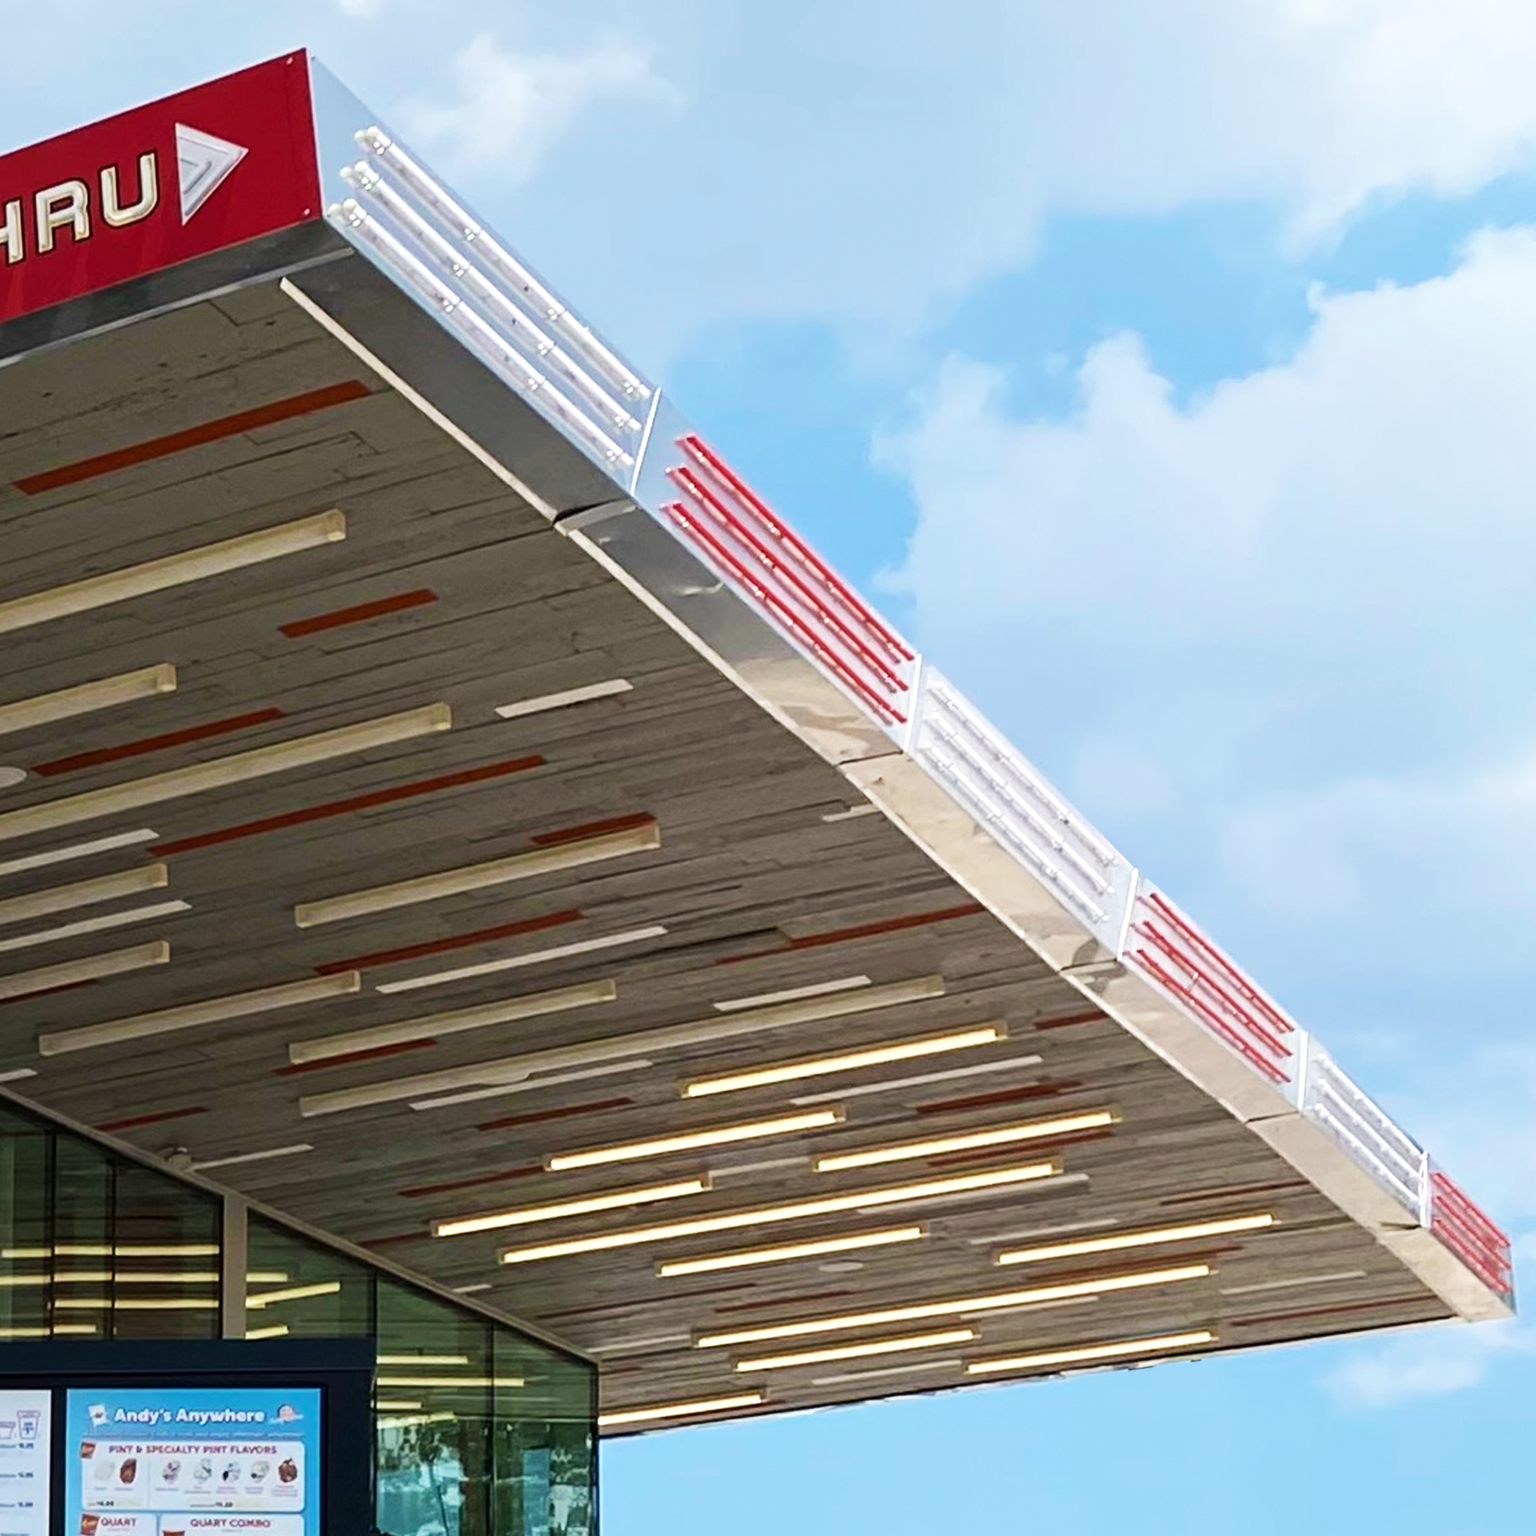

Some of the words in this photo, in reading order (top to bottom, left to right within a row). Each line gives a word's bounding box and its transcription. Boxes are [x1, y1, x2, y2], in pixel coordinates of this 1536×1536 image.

[114, 1409, 171, 1425] Andy's
[176, 1409, 265, 1425] Anywhere
[146, 1445, 199, 1454] SPECIALTY
[230, 1445, 277, 1454] FLAVORS
[101, 1518, 137, 1528] QUART
[190, 1518, 226, 1528] QUART
[229, 1518, 271, 1528] COMBO
